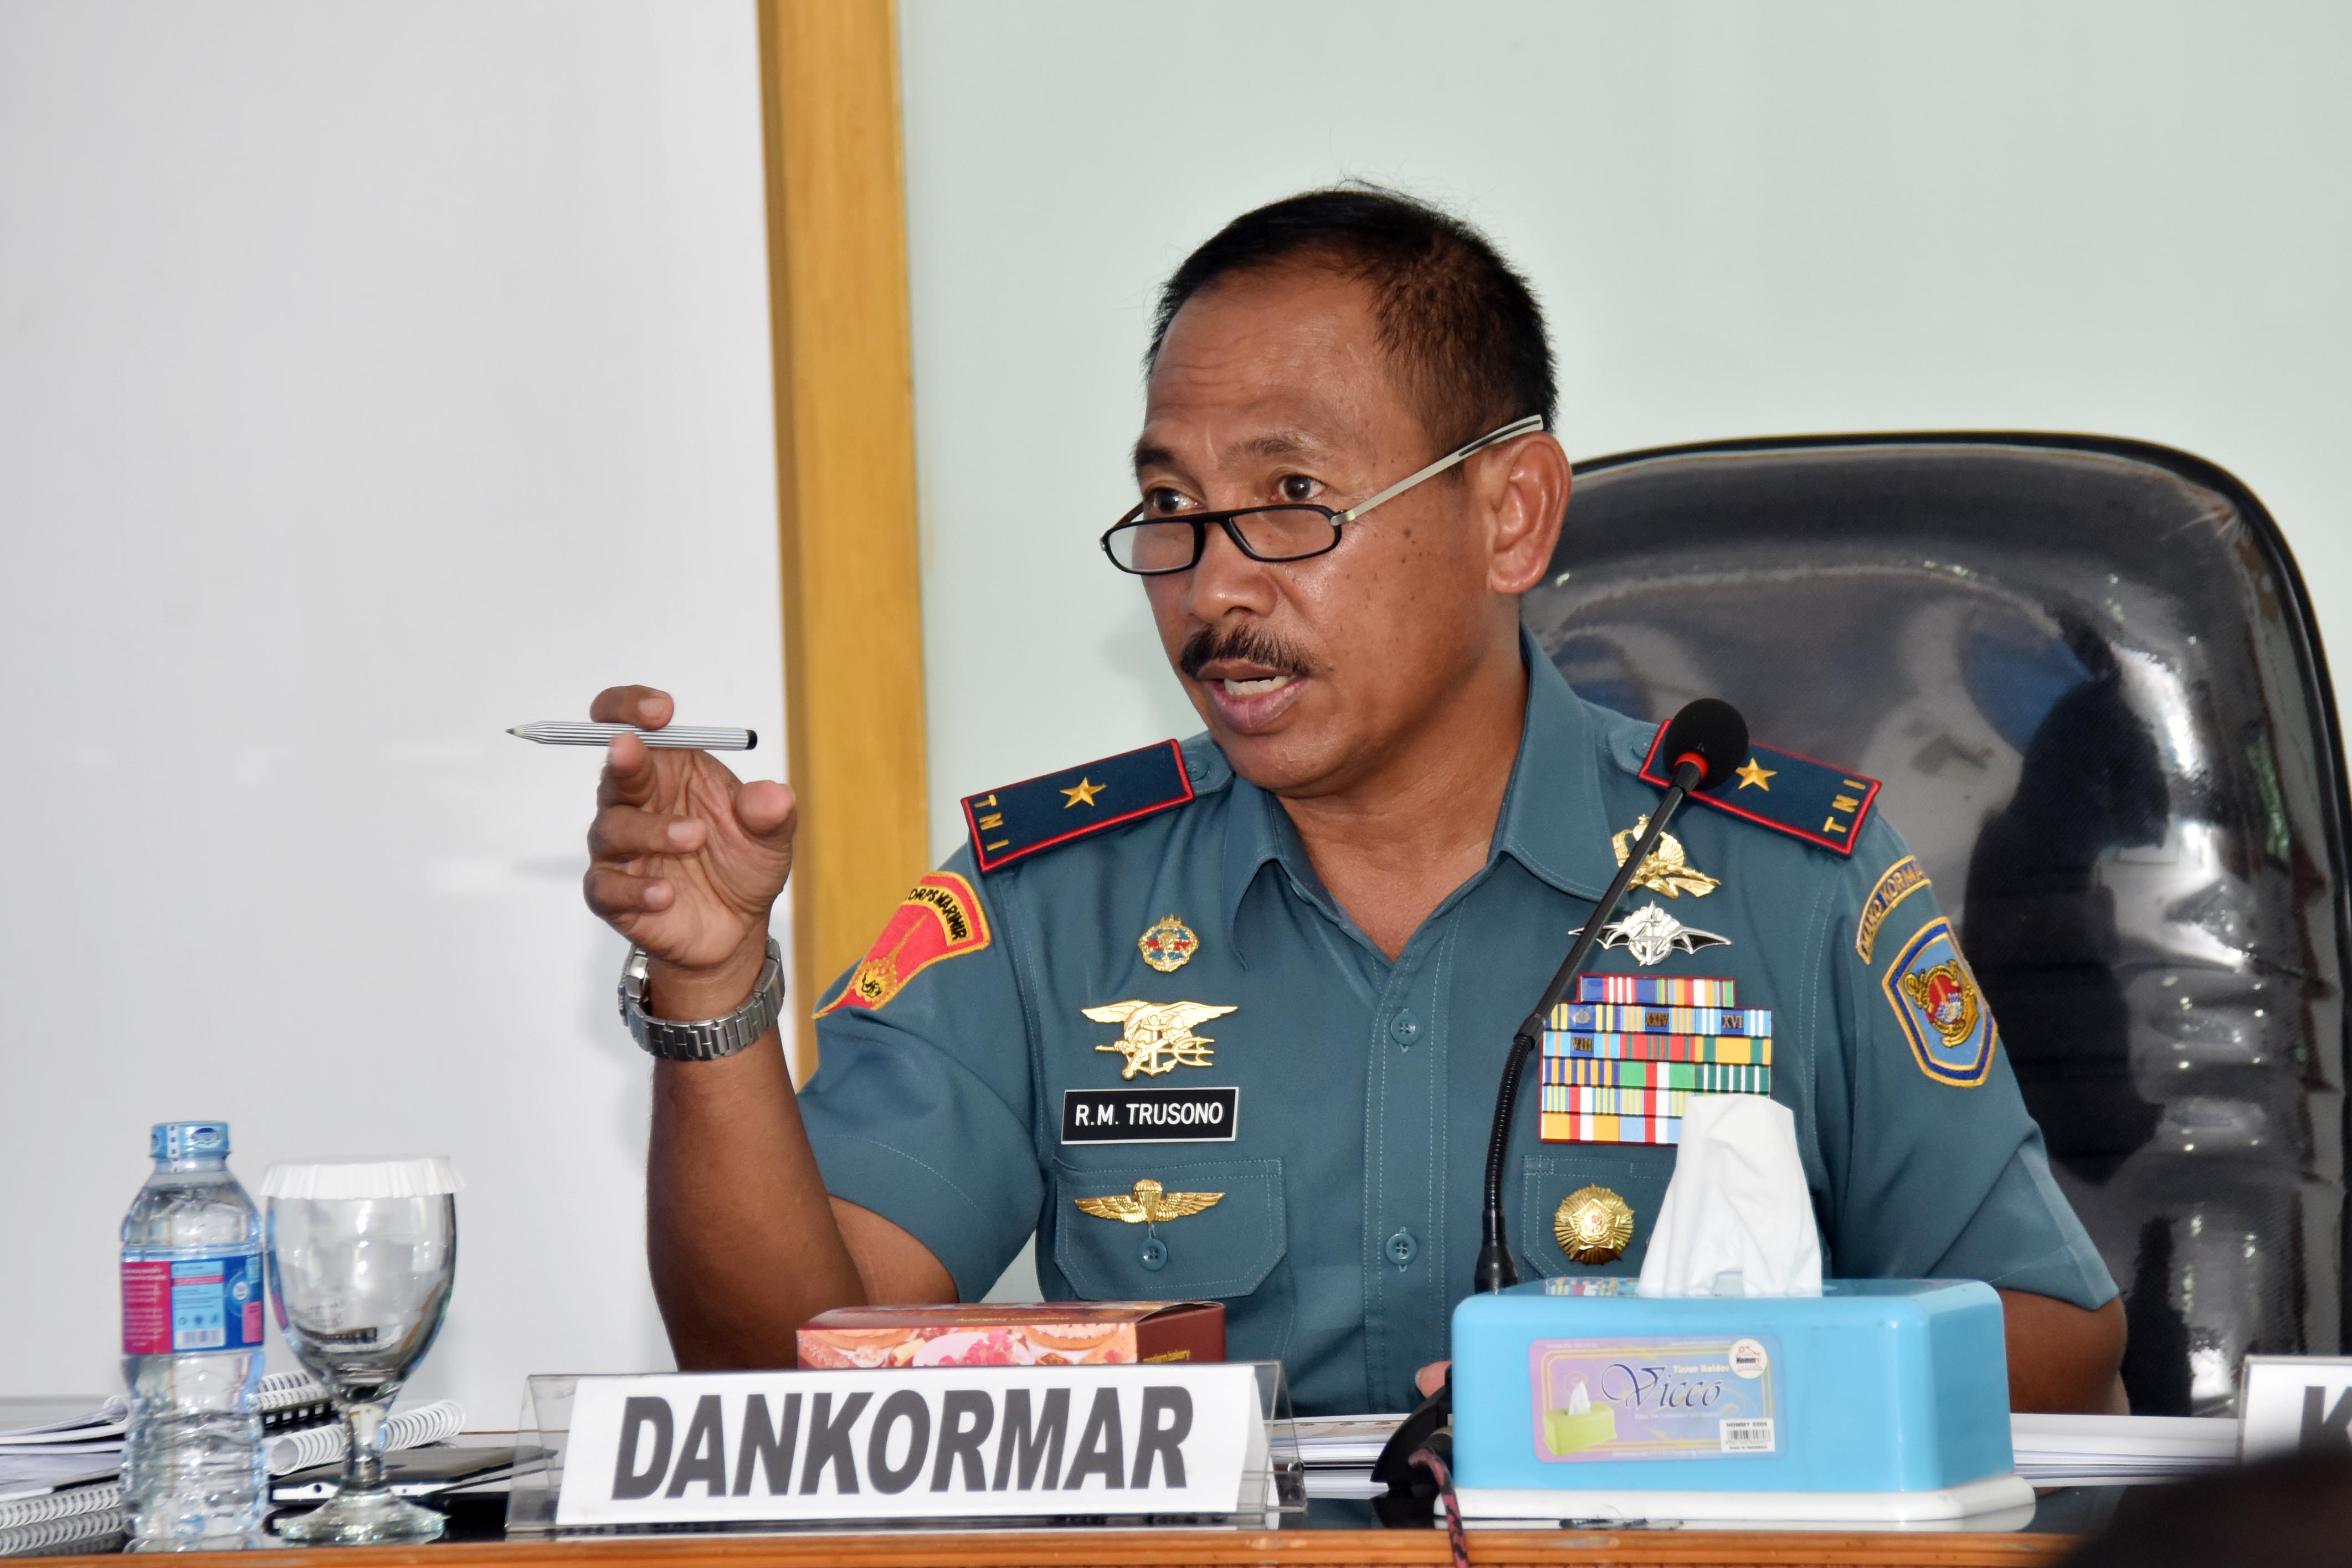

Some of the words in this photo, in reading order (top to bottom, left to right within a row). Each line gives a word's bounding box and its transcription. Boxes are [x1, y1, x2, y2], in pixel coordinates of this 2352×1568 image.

[974, 794, 1009, 851] TNI
[1822, 779, 1866, 834] TNI
[906, 888, 939, 902] ORPS
[1722, 1015, 1743, 1029] XVI
[1075, 1104, 1119, 1127] R.M.
[1126, 1102, 1223, 1125] TRUSONO
[1601, 1364, 1722, 1408] Vicco
[612, 1386, 1194, 1500] DANKORMAR
